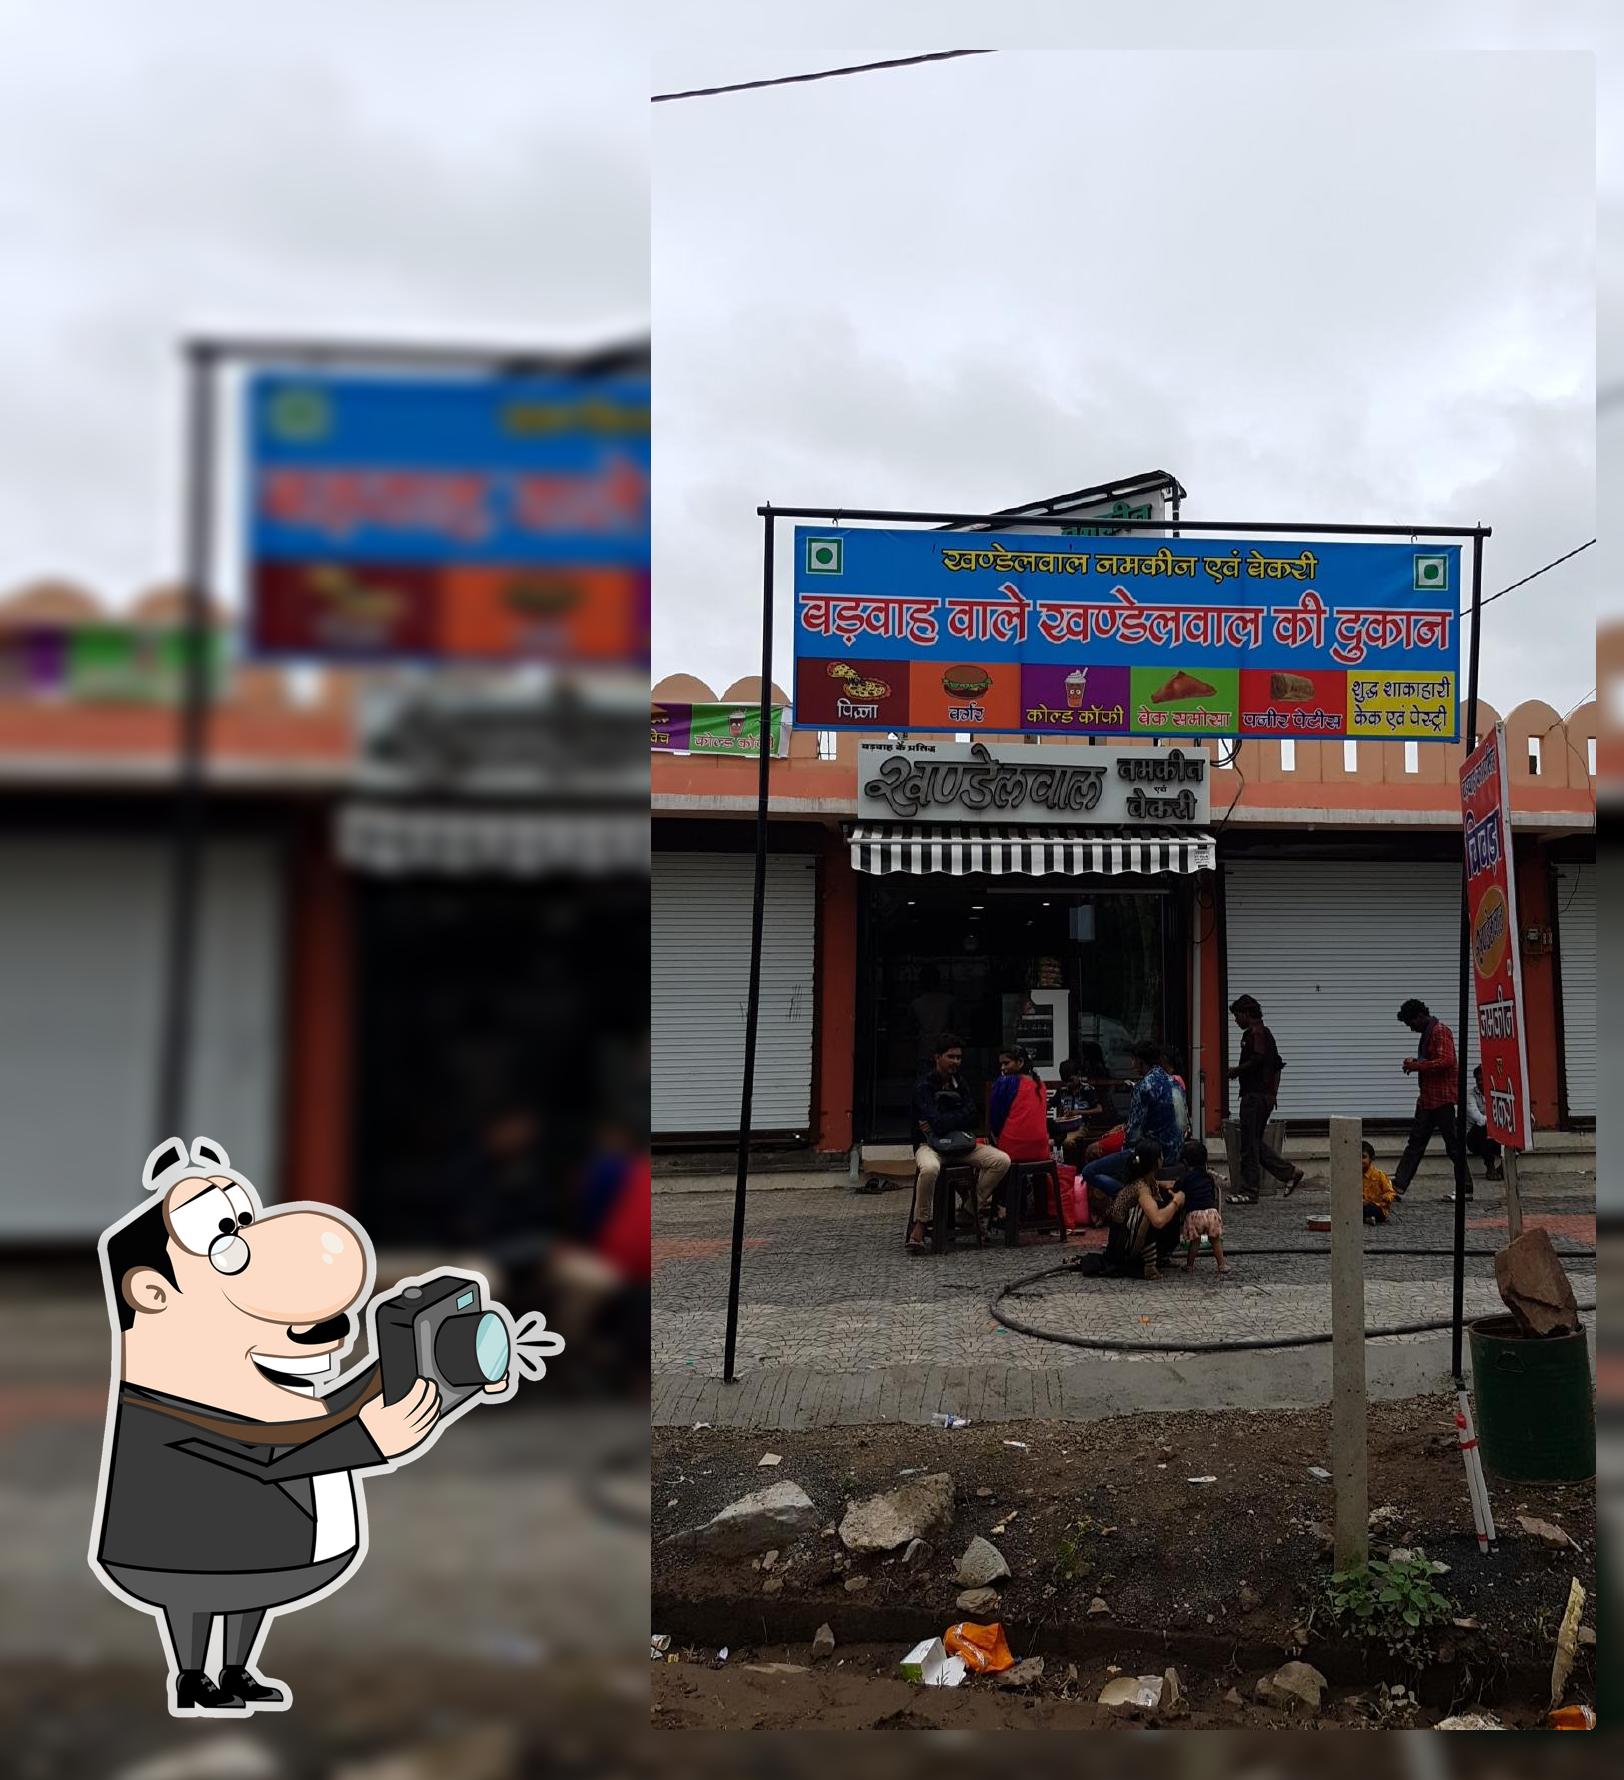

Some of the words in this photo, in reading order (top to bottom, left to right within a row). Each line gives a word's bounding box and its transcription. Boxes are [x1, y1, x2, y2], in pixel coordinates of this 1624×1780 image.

[942, 541, 1090, 576] खण्डेलवाल
[1095, 547, 1198, 578] नमकीन
[1203, 549, 1241, 584] एवं
[1246, 550, 1318, 580] बेकरी
[799, 593, 941, 646] बड़वाह
[946, 582, 1033, 645] वाले
[1037, 584, 1265, 650] खण्डेलवाल
[1271, 590, 1329, 649] की
[1330, 607, 1453, 664] दुकान
[1351, 679, 1379, 703] शुद्ध
[1383, 676, 1450, 700] शाकाहारी
[1026, 704, 1073, 724] कोल्ड
[1137, 705, 1169, 727] बेक
[1171, 706, 1231, 727] समोसा
[1242, 707, 1288, 728] पनीर
[1354, 705, 1382, 727] केक
[1386, 703, 1405, 731] एवं
[1410, 704, 1447, 732] पेस्ट्री
[864, 743, 1107, 817] खण्डेलवाल
[1116, 749, 1205, 782] नमकीन
[1126, 788, 1198, 820] बेकरी
[1479, 985, 1515, 1040] नमकीन
[1490, 1075, 1516, 1133] बेकरी
